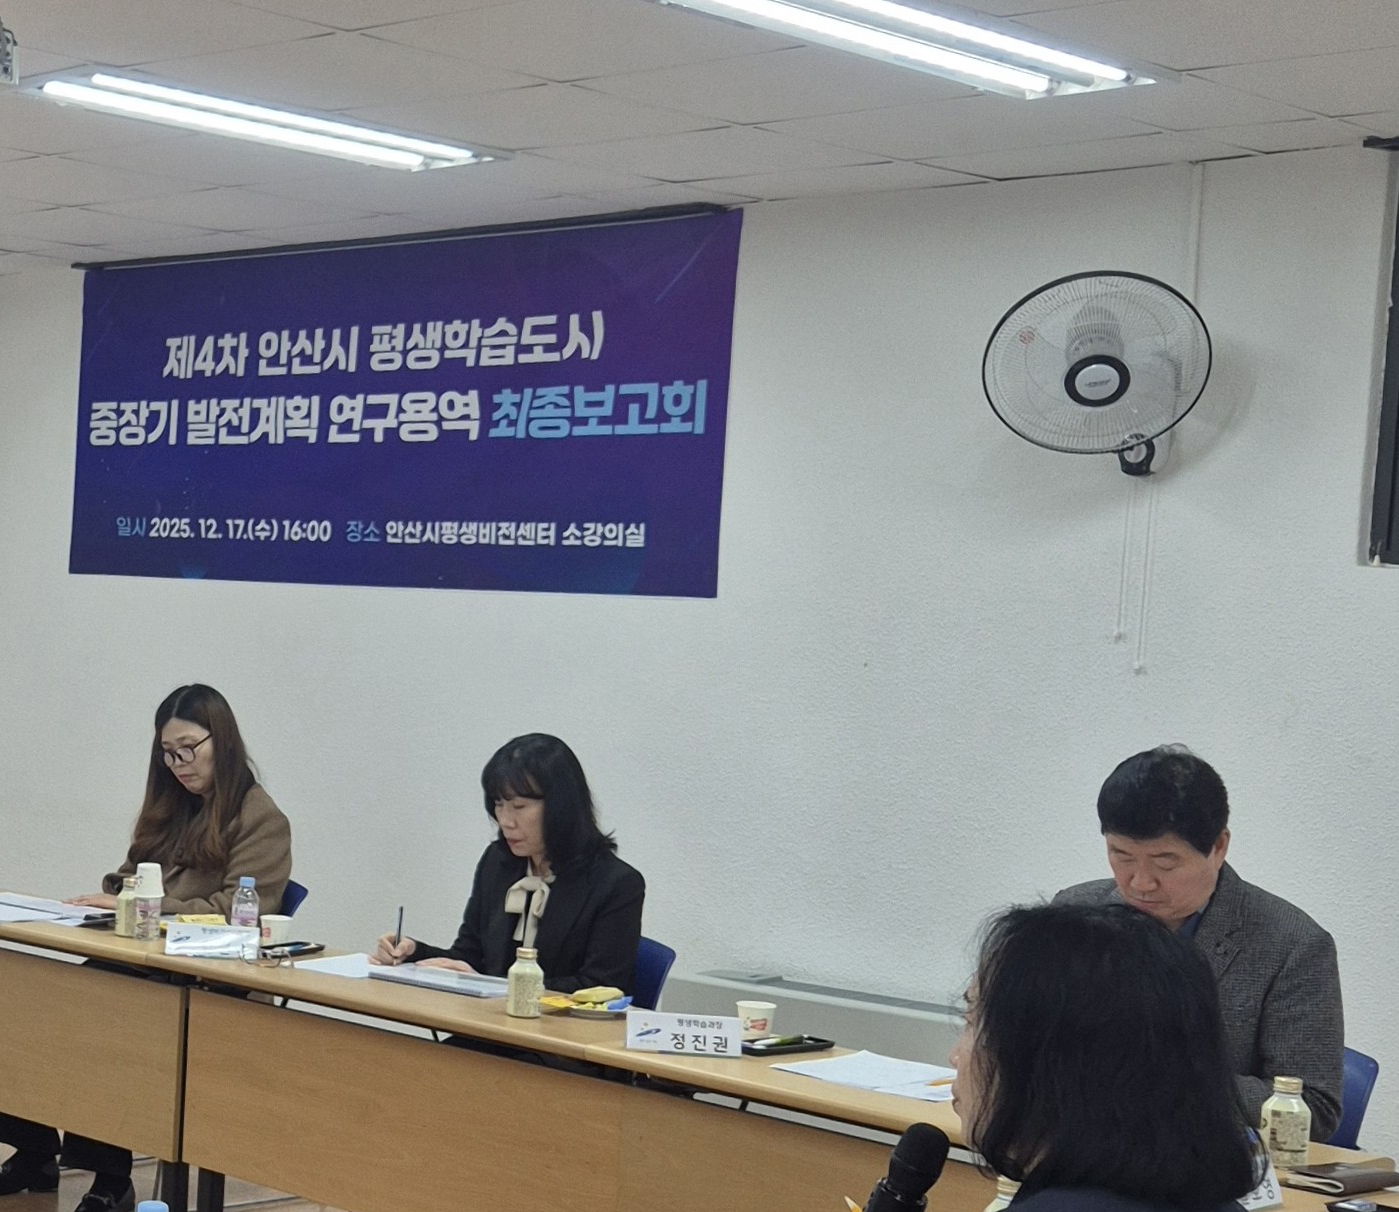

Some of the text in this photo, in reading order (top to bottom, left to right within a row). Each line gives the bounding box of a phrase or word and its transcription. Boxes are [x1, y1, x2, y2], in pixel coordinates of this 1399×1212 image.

[162, 310, 605, 379] 제4차 안산시 평생학습도시
[88, 378, 707, 446] 중장기 발전계획 연구용역 최종보고회
[115, 516, 645, 548] 일시 2025. 12. 17.(수) 16:00 장소 안산시평생비전센터 소강의실
[676, 1018, 723, 1030] 평생학습과장
